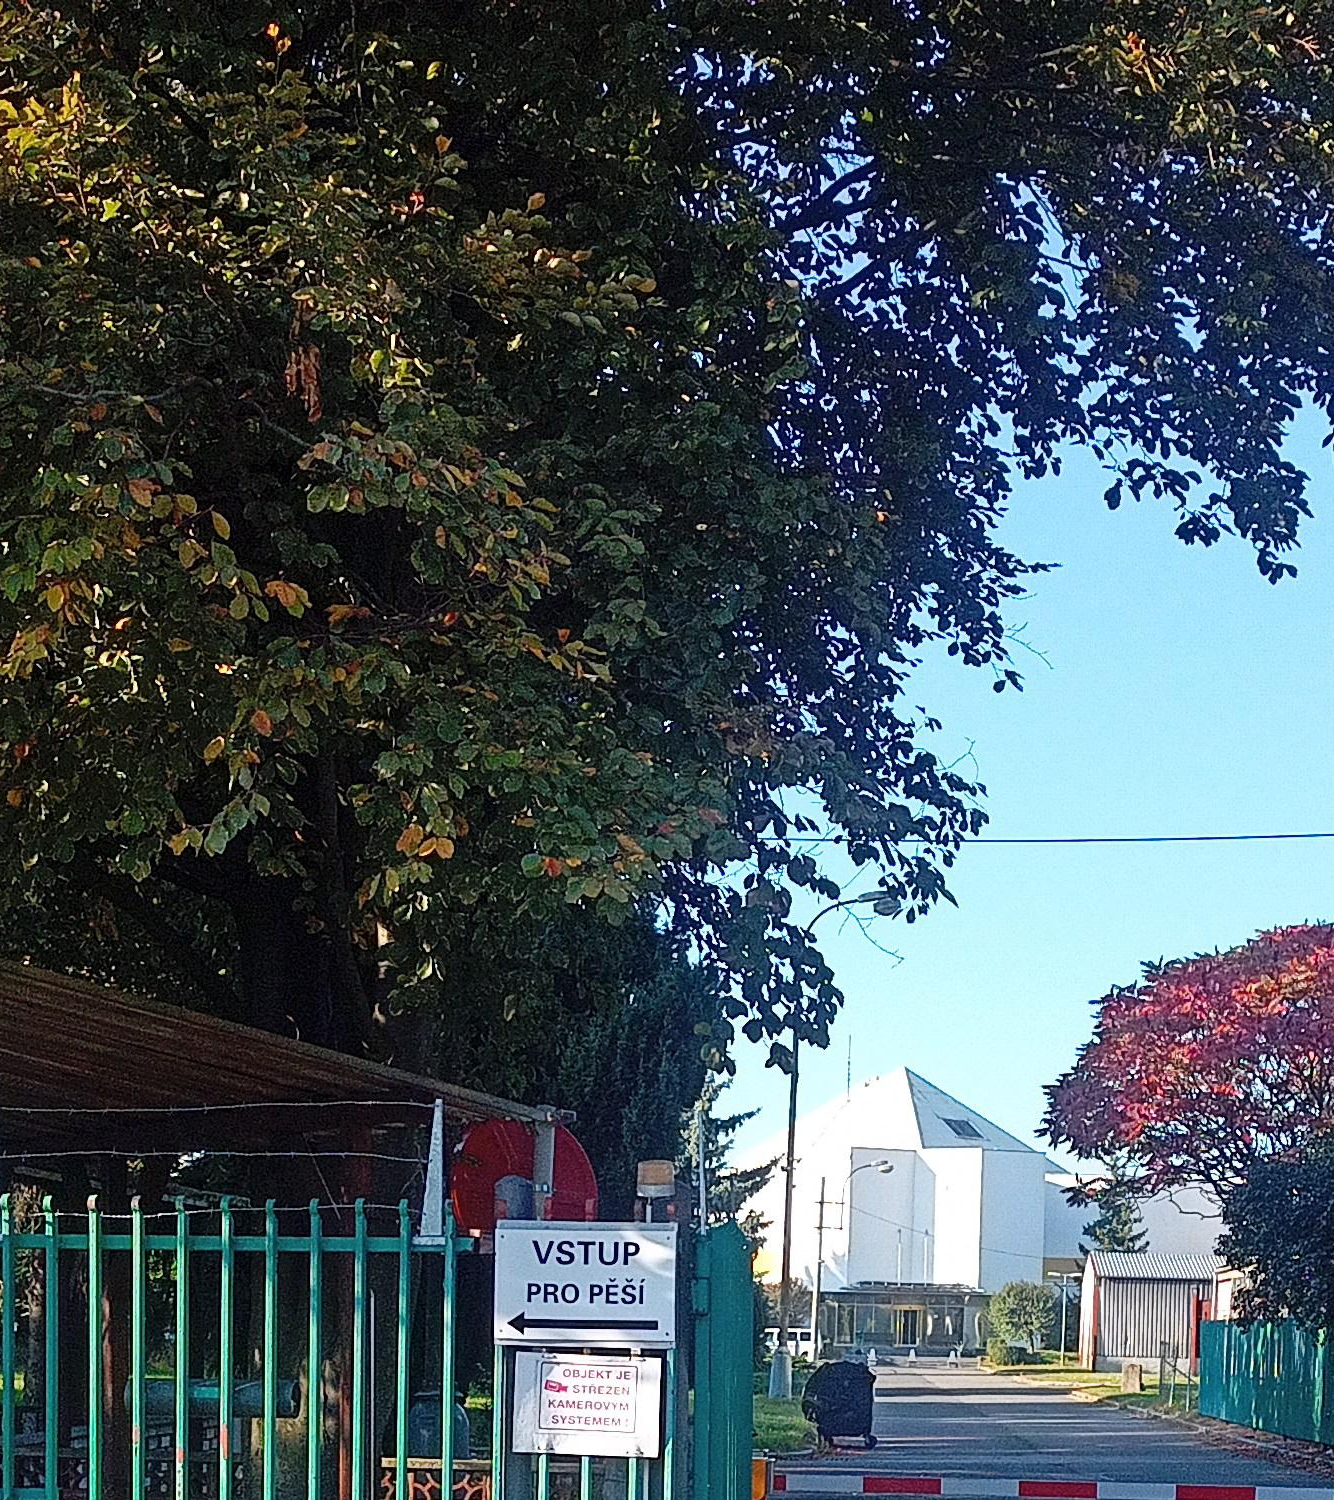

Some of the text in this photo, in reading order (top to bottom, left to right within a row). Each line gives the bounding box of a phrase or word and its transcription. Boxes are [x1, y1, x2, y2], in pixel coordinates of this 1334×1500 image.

[532, 1240, 641, 1266] VSTUP
[527, 1277, 646, 1305] PRO PĚŠÍ
[562, 1368, 632, 1381] OBJEKT JE
